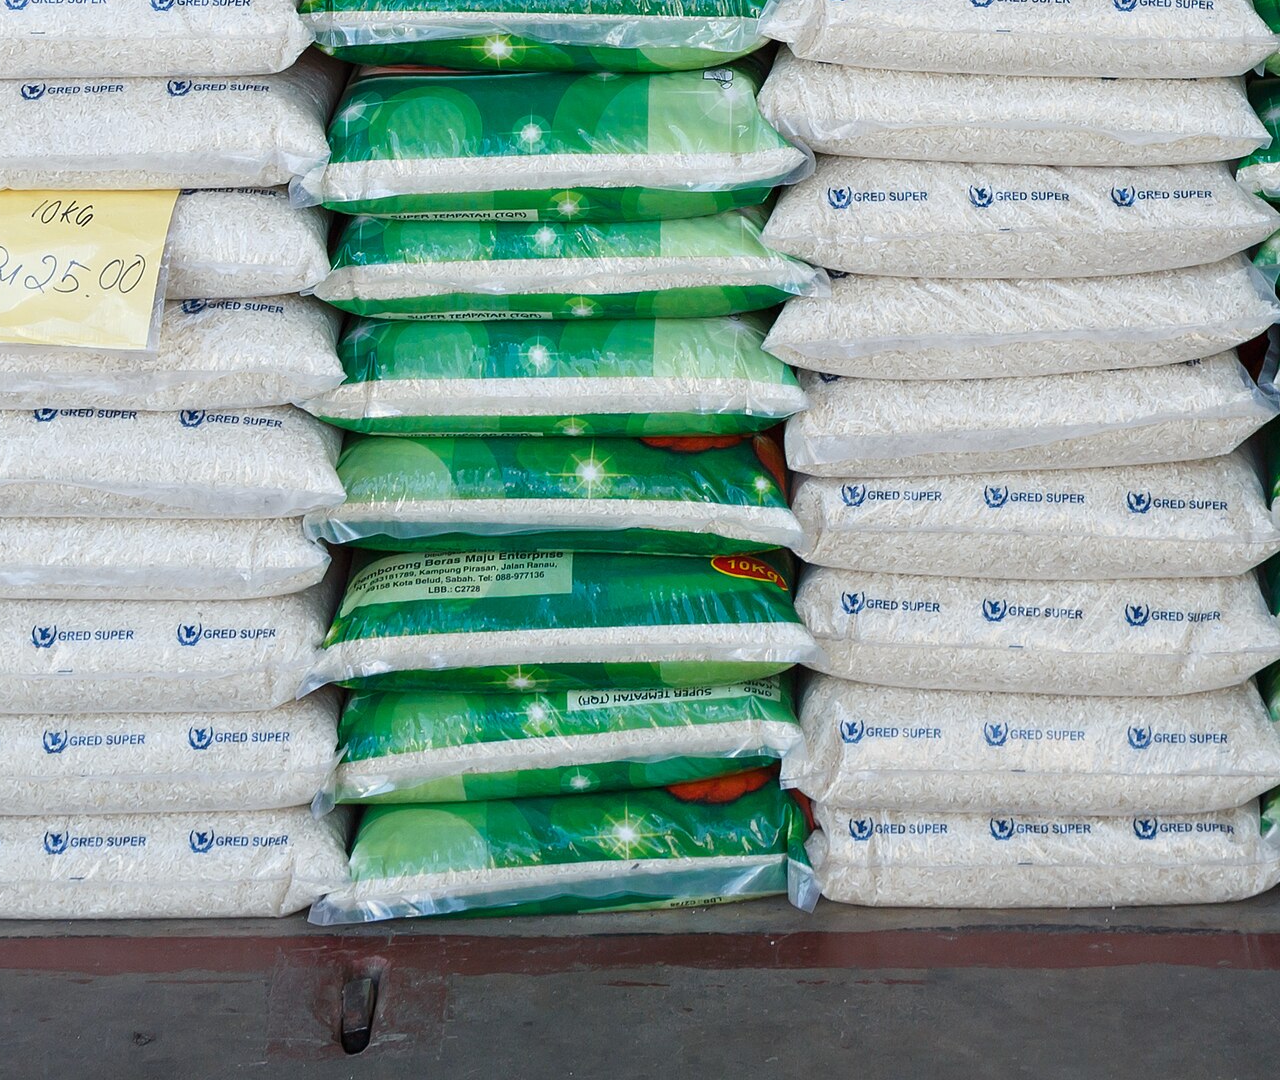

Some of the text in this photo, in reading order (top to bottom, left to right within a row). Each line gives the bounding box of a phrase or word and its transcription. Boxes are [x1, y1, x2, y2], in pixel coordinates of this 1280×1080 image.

[1009, 491, 1085, 504] GRED SUPER
[1152, 497, 1229, 511] GRED SUPER
[425, 556, 461, 567] Beras
[465, 554, 495, 564] Maju
[499, 551, 563, 561] Enterprise
[419, 561, 558, 576] Kampung Pirasan, Jalan Ranau,
[725, 557, 784, 586] 10Kg
[393, 571, 545, 588] Kota Belud, Sabah. Tel: 088-977136
[428, 585, 481, 594] LBB.: C2728
[57, 629, 135, 642] GRED SUPER
[203, 628, 276, 641] GRED SUPER
[614, 691, 670, 703] TEMPATAN
[674, 687, 712, 698] SUPER
[578, 695, 610, 706] (TQR)
[874, 823, 948, 835] GRED SUPER
[1159, 822, 1236, 836] GRED SUPER
[70, 835, 147, 848] GRED SUPER
[215, 834, 289, 848] GRED SUPER
